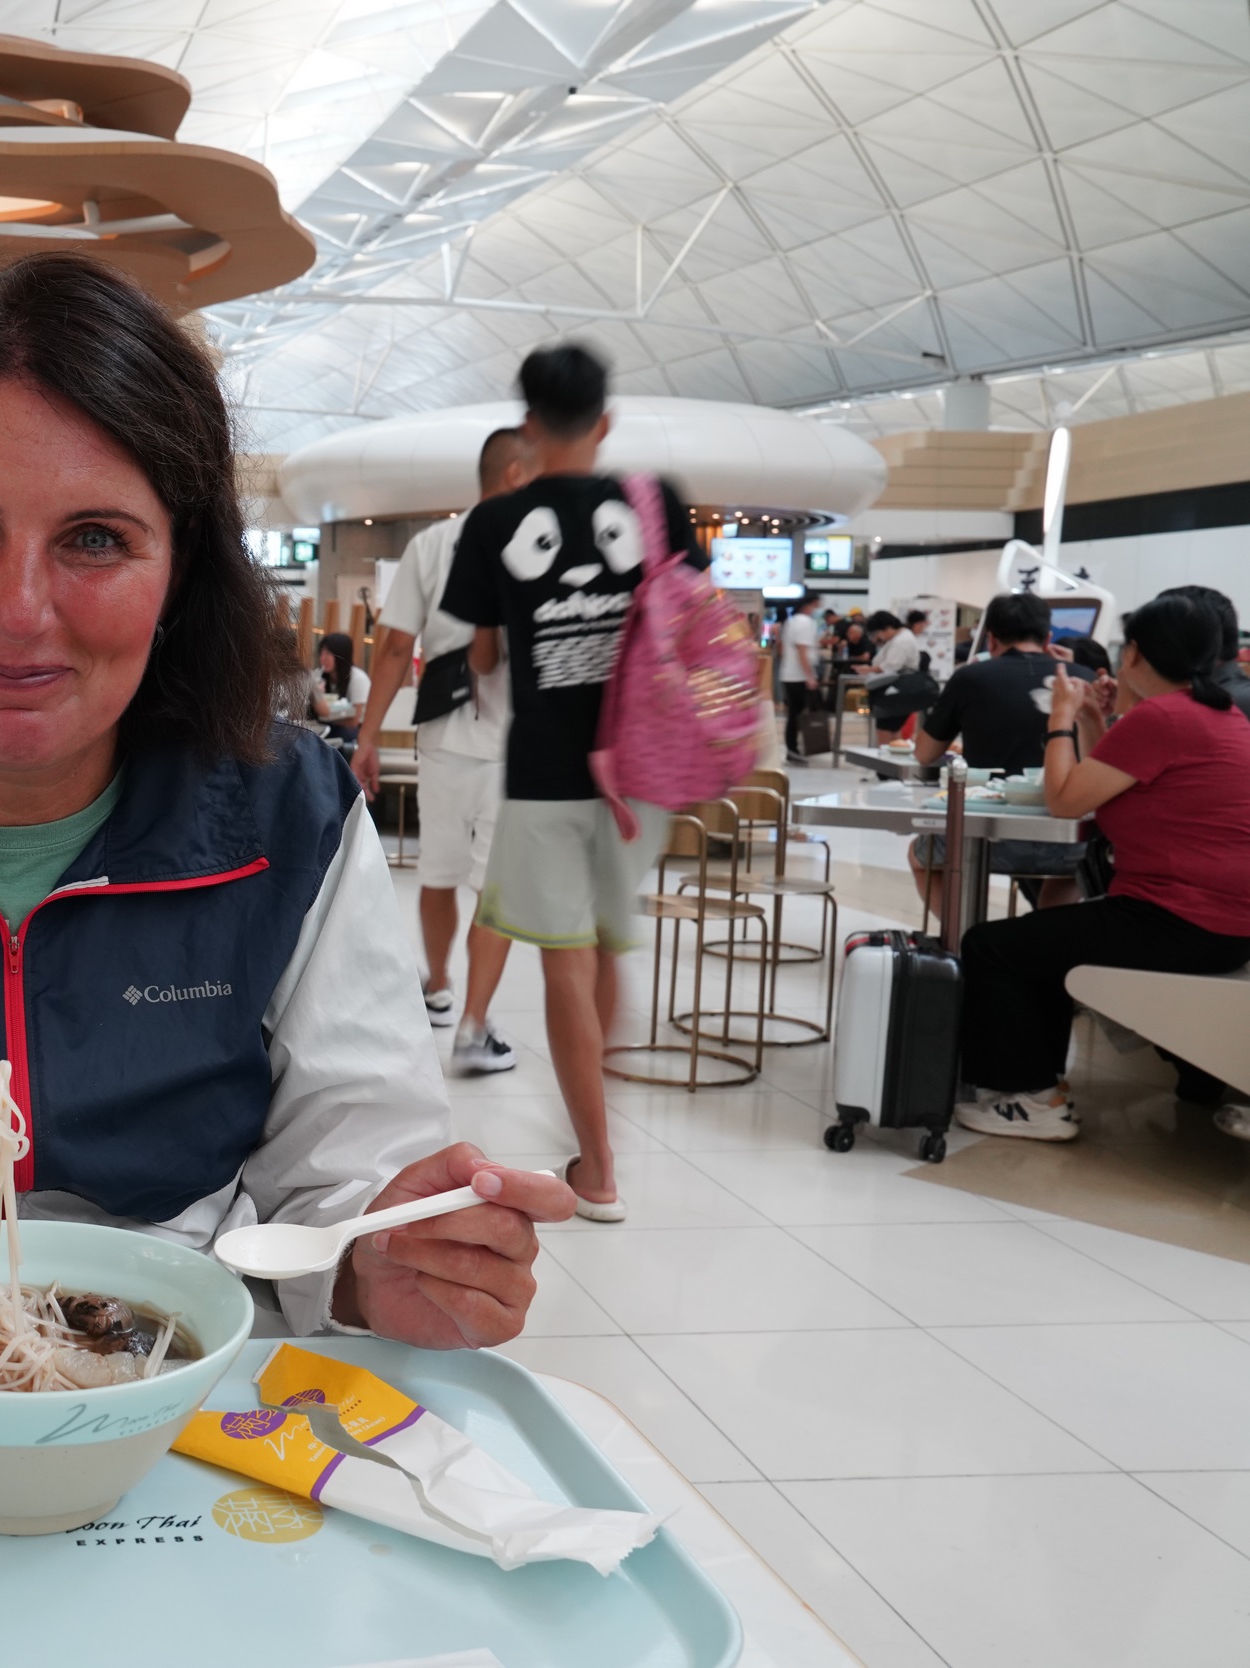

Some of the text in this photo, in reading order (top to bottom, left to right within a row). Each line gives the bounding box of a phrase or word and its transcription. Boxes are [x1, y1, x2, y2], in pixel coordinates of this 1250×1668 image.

[144, 980, 233, 1003] Columbia
[136, 1514, 203, 1530] Thai
[76, 1535, 204, 1547] EXPRESS
